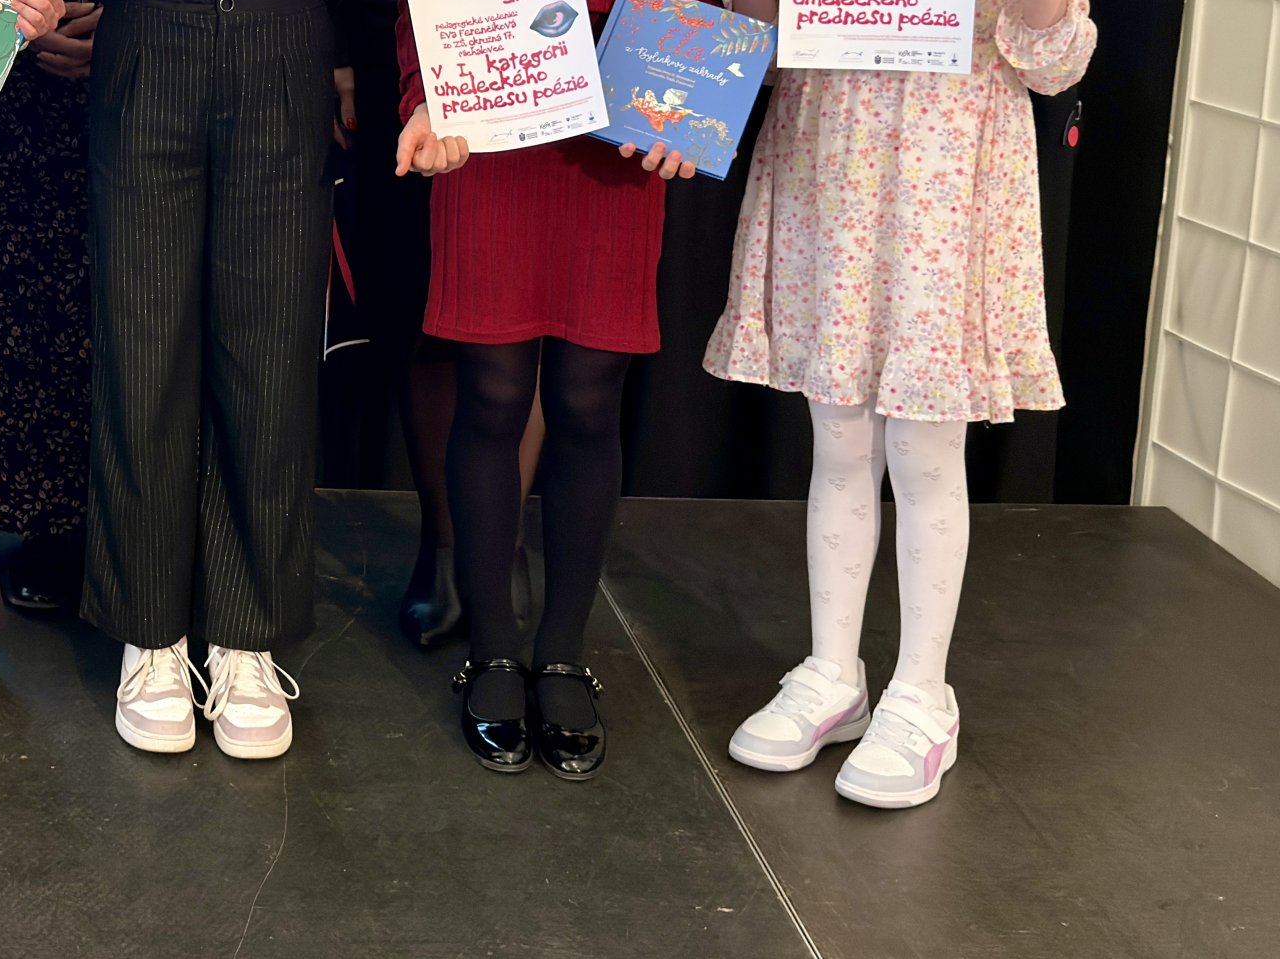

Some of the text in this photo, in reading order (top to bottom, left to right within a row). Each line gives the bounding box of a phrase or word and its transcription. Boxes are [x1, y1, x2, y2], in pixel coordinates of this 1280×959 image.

[796, 7, 960, 31] prednesu poézie
[440, 31, 457, 40] Eva
[658, 28, 705, 63] Ela
[485, 41, 568, 74] kategórii
[434, 68, 548, 98] umeleckého
[442, 74, 589, 119] prednesu poézie
